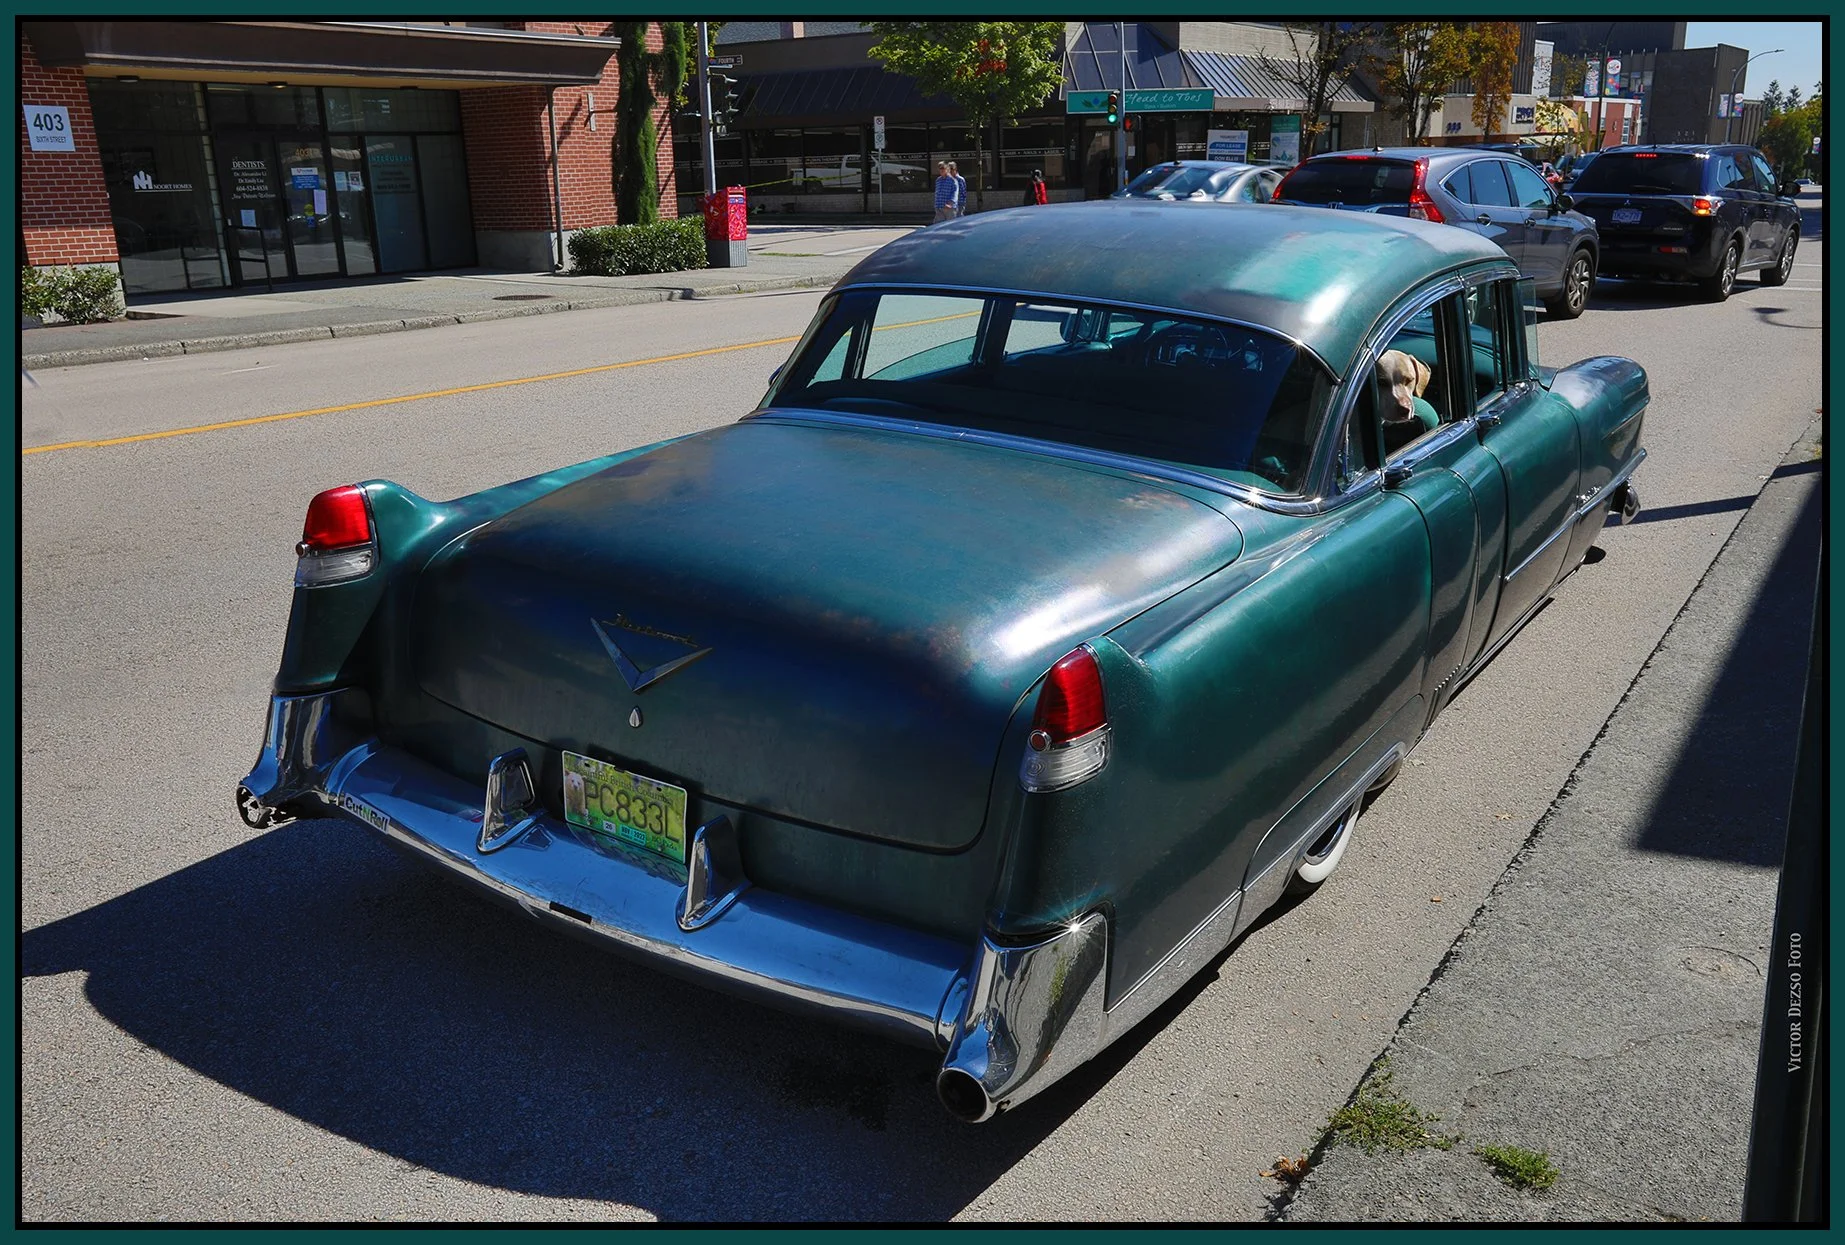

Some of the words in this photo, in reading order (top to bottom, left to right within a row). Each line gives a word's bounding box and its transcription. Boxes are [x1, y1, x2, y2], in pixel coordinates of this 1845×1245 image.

[1125, 93, 1158, 105] Head
[1163, 93, 1173, 103] to
[1175, 92, 1202, 102] Toes
[33, 113, 64, 131] 403
[50, 136, 67, 144] STREET
[346, 796, 388, 831] CutNRoll
[584, 779, 680, 843] PC833L
